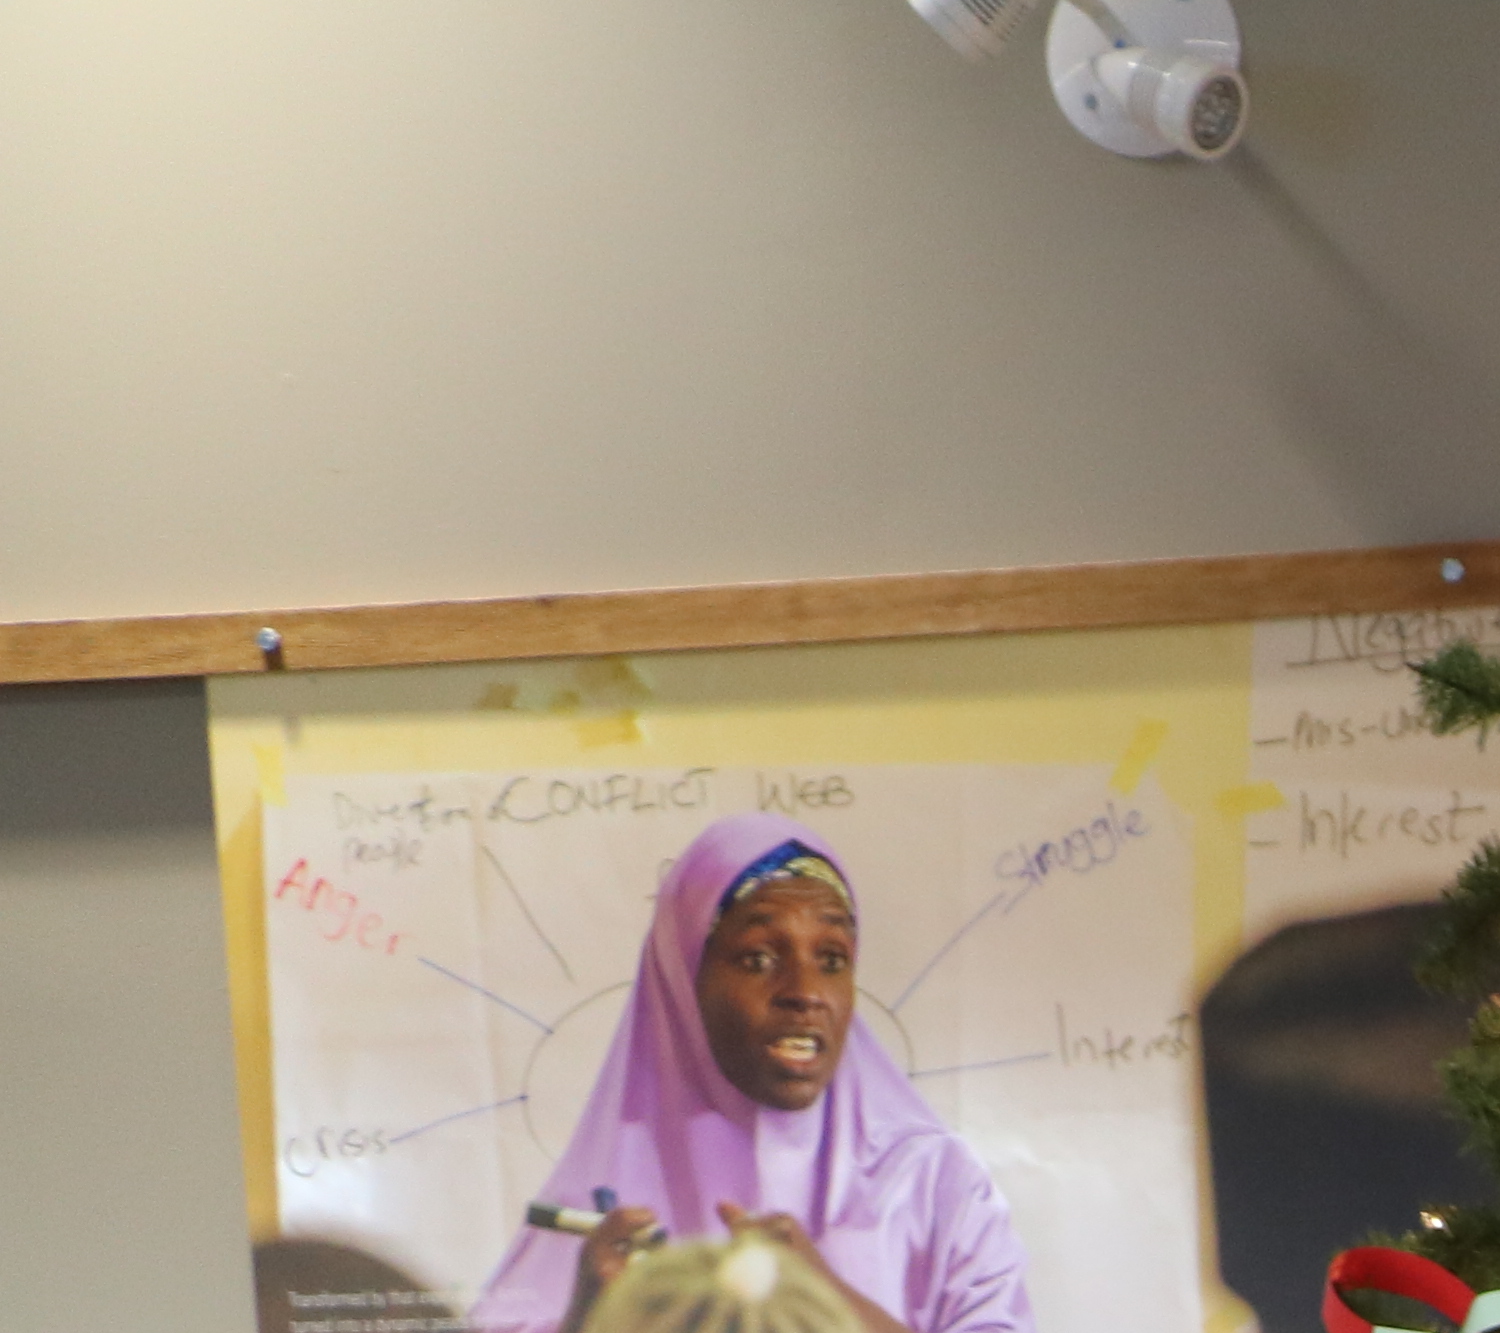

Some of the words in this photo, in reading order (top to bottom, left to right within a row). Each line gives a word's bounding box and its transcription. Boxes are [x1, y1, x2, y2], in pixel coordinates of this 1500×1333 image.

[490, 766, 716, 824] CONFLICT
[757, 771, 855, 815] WEB
[273, 857, 418, 957] Anger
